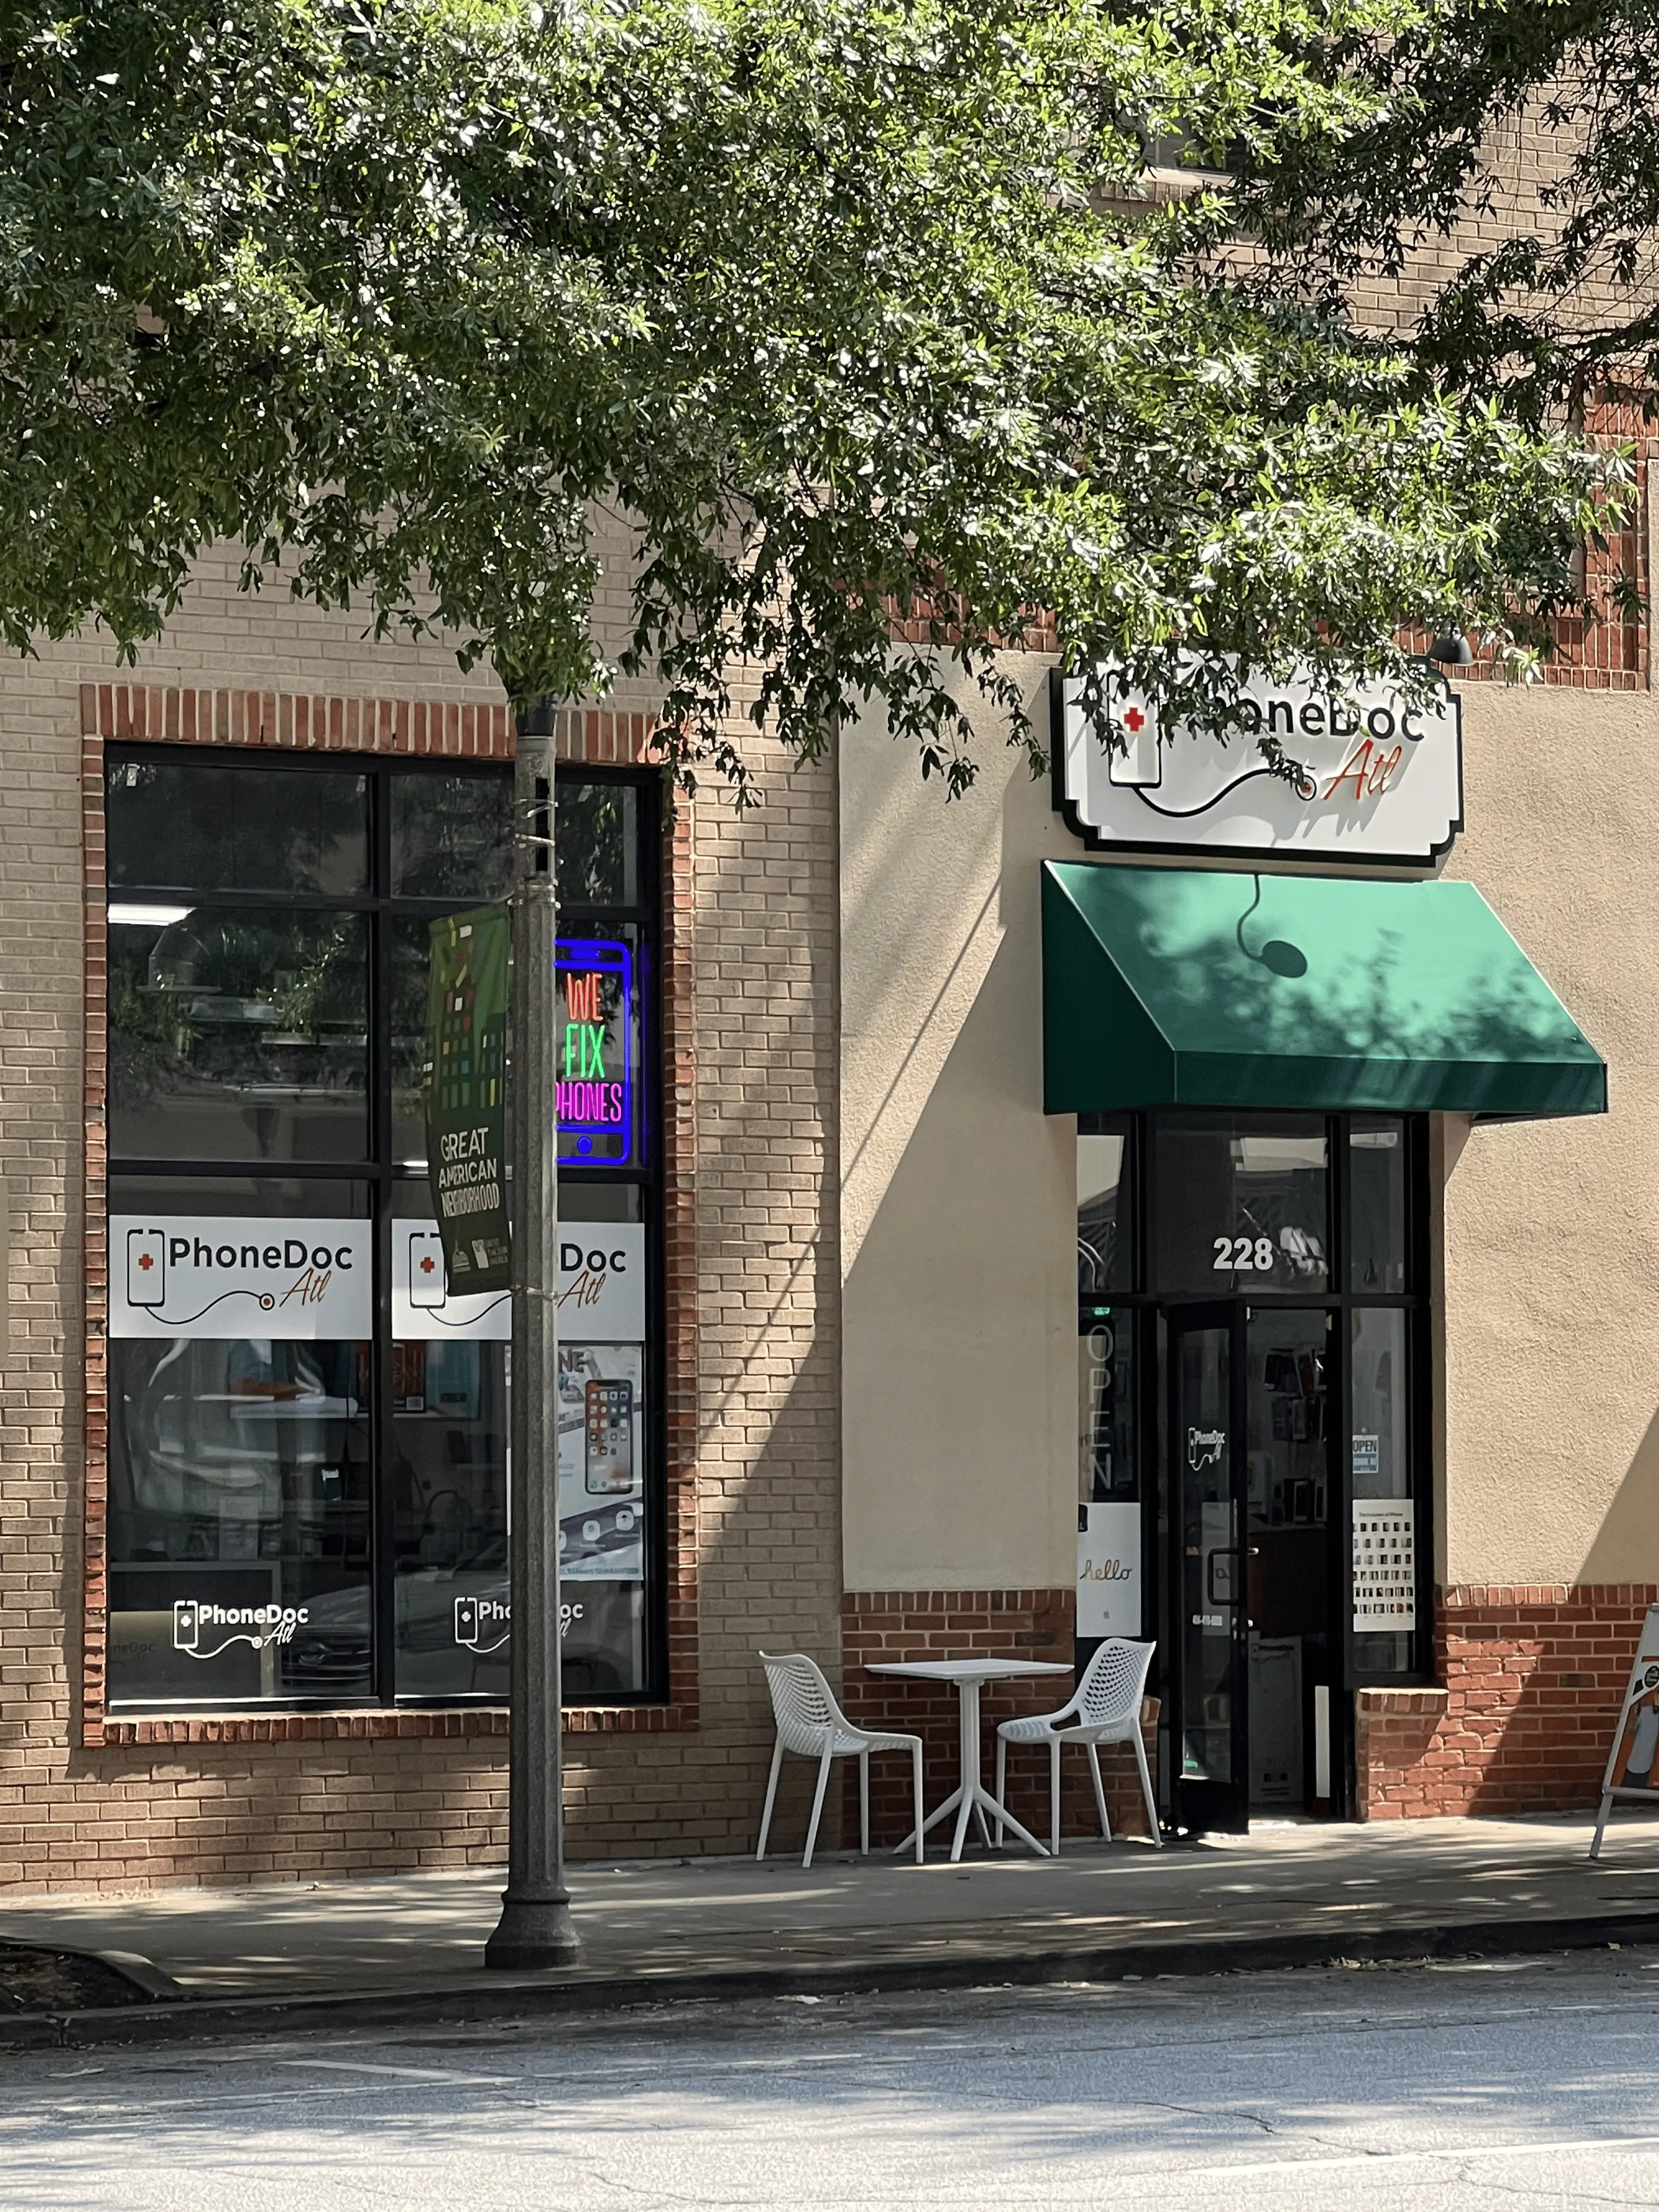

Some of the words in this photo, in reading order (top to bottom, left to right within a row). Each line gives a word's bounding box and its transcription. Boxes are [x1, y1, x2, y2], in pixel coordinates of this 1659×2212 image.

[1210, 689, 1425, 742] oneDoc
[1323, 738, 1402, 801] Atl
[567, 972, 604, 1021] WE
[565, 1023, 605, 1078] FIX
[440, 1127, 489, 1162] GREAT
[438, 1158, 497, 1189] AMERICAN
[170, 1237, 353, 1270] PhoneDoc
[1213, 1237, 1273, 1271] 228
[279, 1267, 332, 1308] Atl
[556, 1269, 607, 1310] Atl
[1086, 1324, 1114, 1490] OPEN
[1352, 1441, 1377, 1453] OPEN
[1079, 1559, 1133, 1581] hello
[199, 1604, 309, 1624] PhoneDoc
[479, 1600, 583, 1620] Phoc
[263, 1621, 297, 1646] Atl
